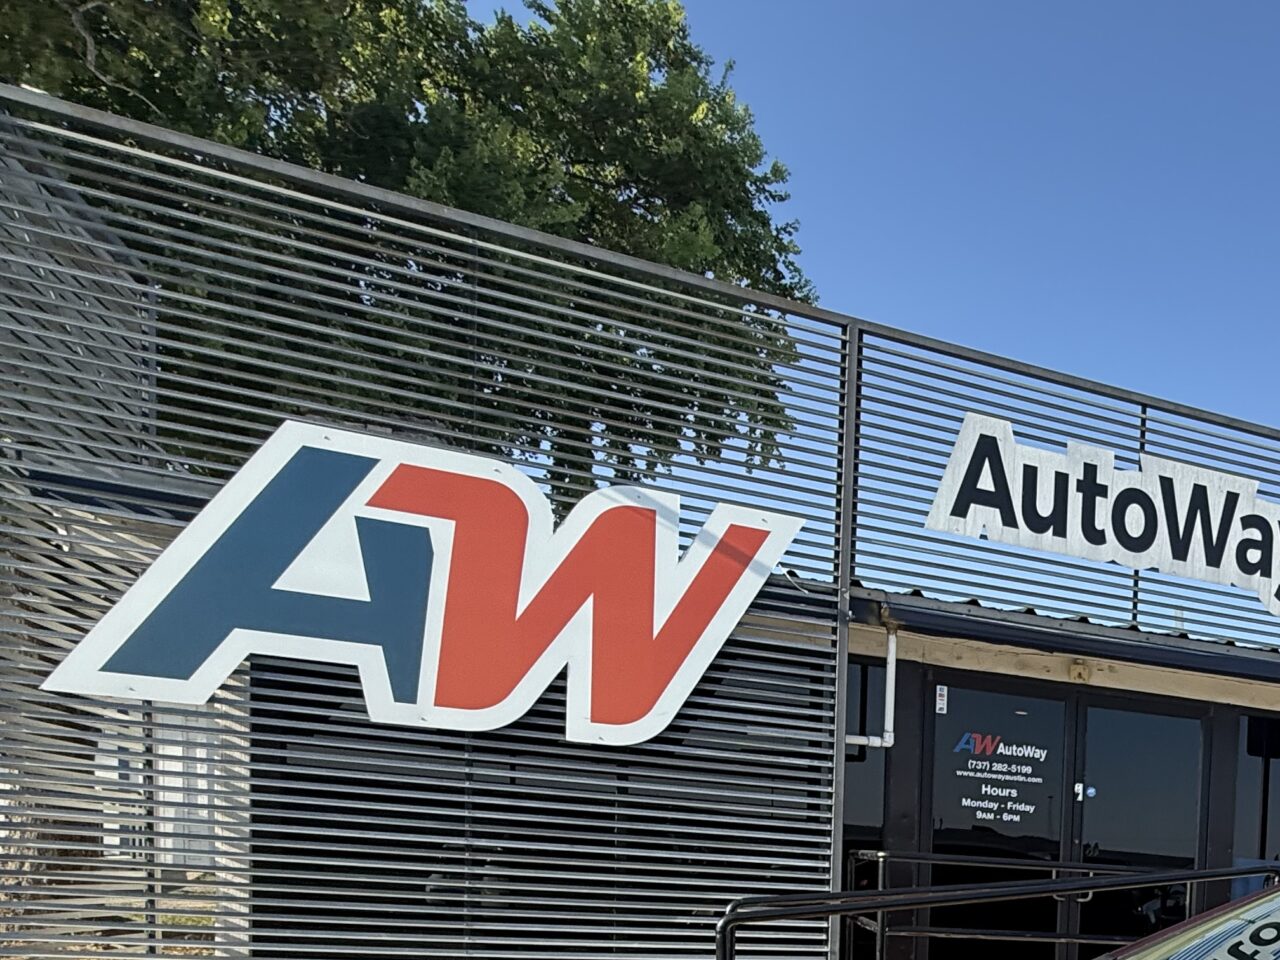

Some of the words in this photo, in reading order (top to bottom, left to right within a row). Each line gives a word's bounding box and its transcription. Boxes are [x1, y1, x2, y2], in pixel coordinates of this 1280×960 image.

[996, 742, 1048, 762] AutoWay
[968, 759, 990, 771] (737)
[991, 762, 1033, 775] 282-5199
[981, 783, 1018, 798] Hours
[961, 797, 999, 811] Monday
[1007, 801, 1036, 814] Friday
[975, 810, 994, 820] 9AM
[1002, 812, 1020, 823] 6PM
